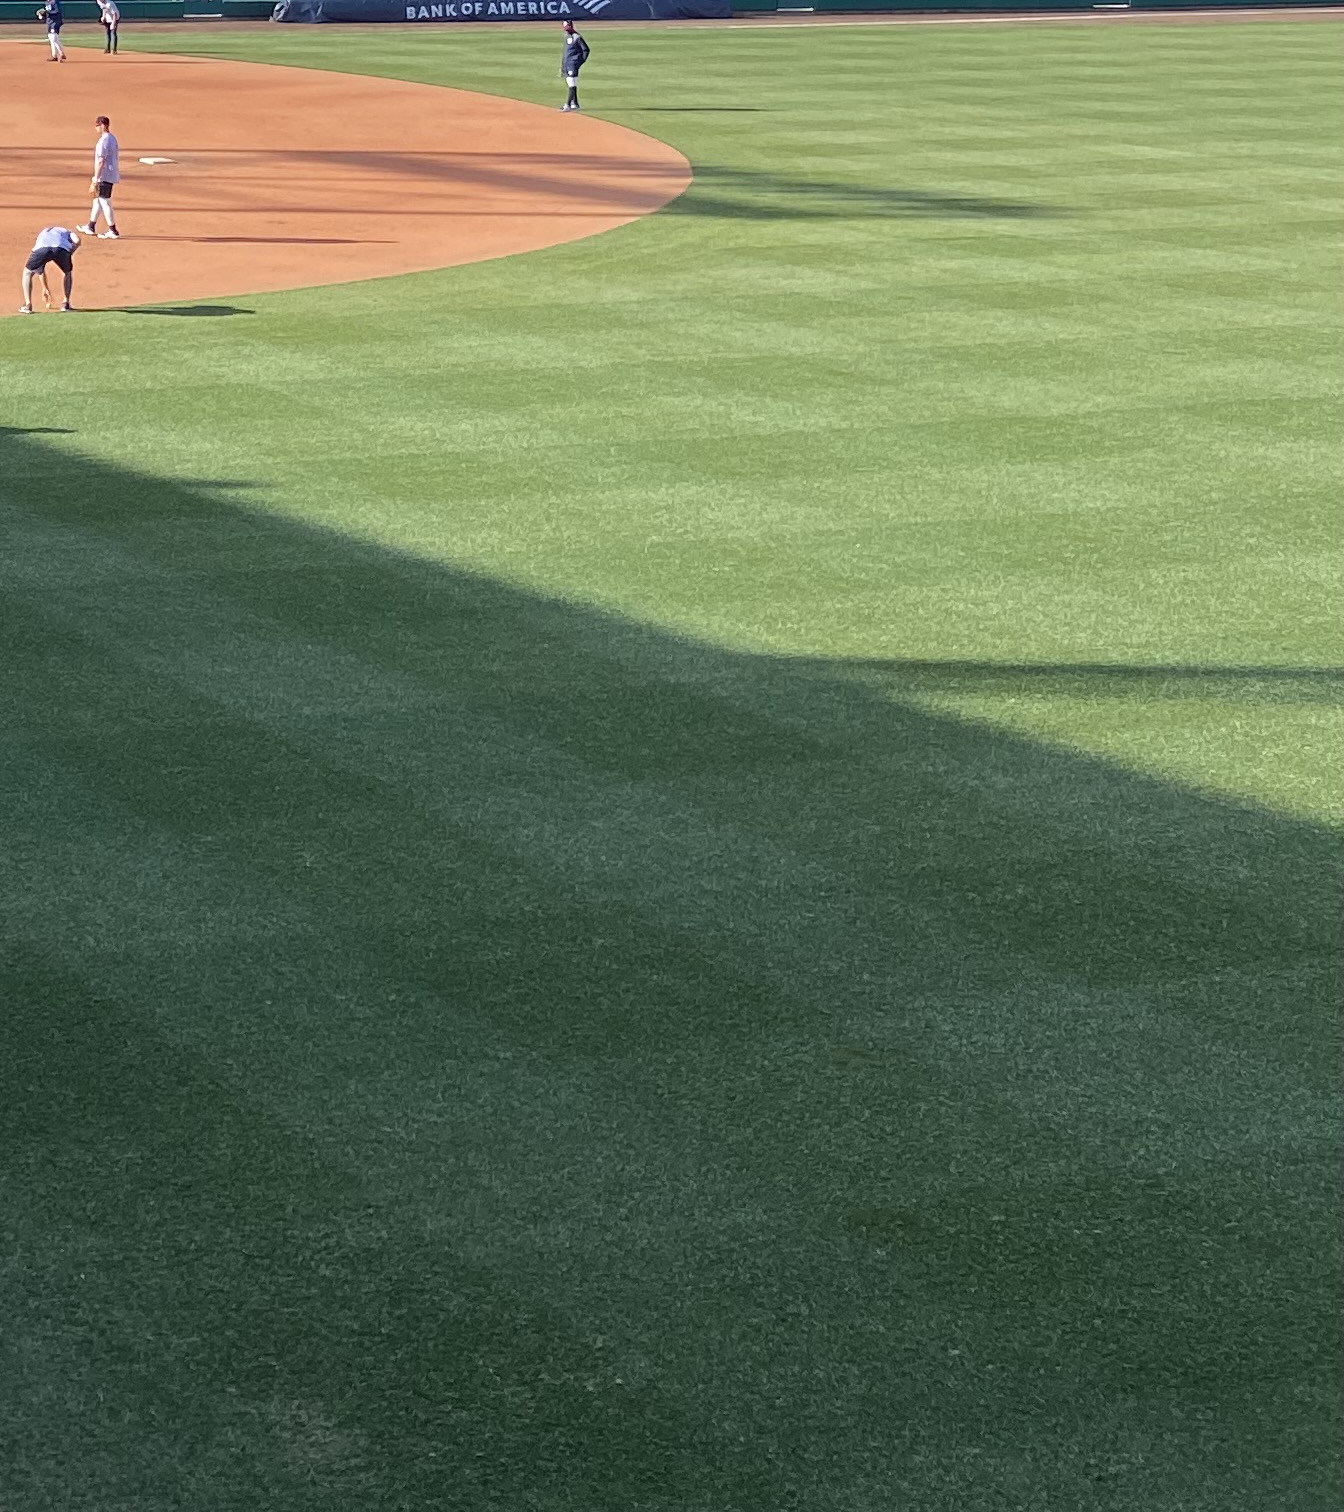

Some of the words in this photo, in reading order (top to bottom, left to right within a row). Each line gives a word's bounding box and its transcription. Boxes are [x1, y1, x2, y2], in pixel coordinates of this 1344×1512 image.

[406, 4, 457, 19] BANK
[460, 2, 483, 16] OF
[487, 1, 571, 15] AMERICA
